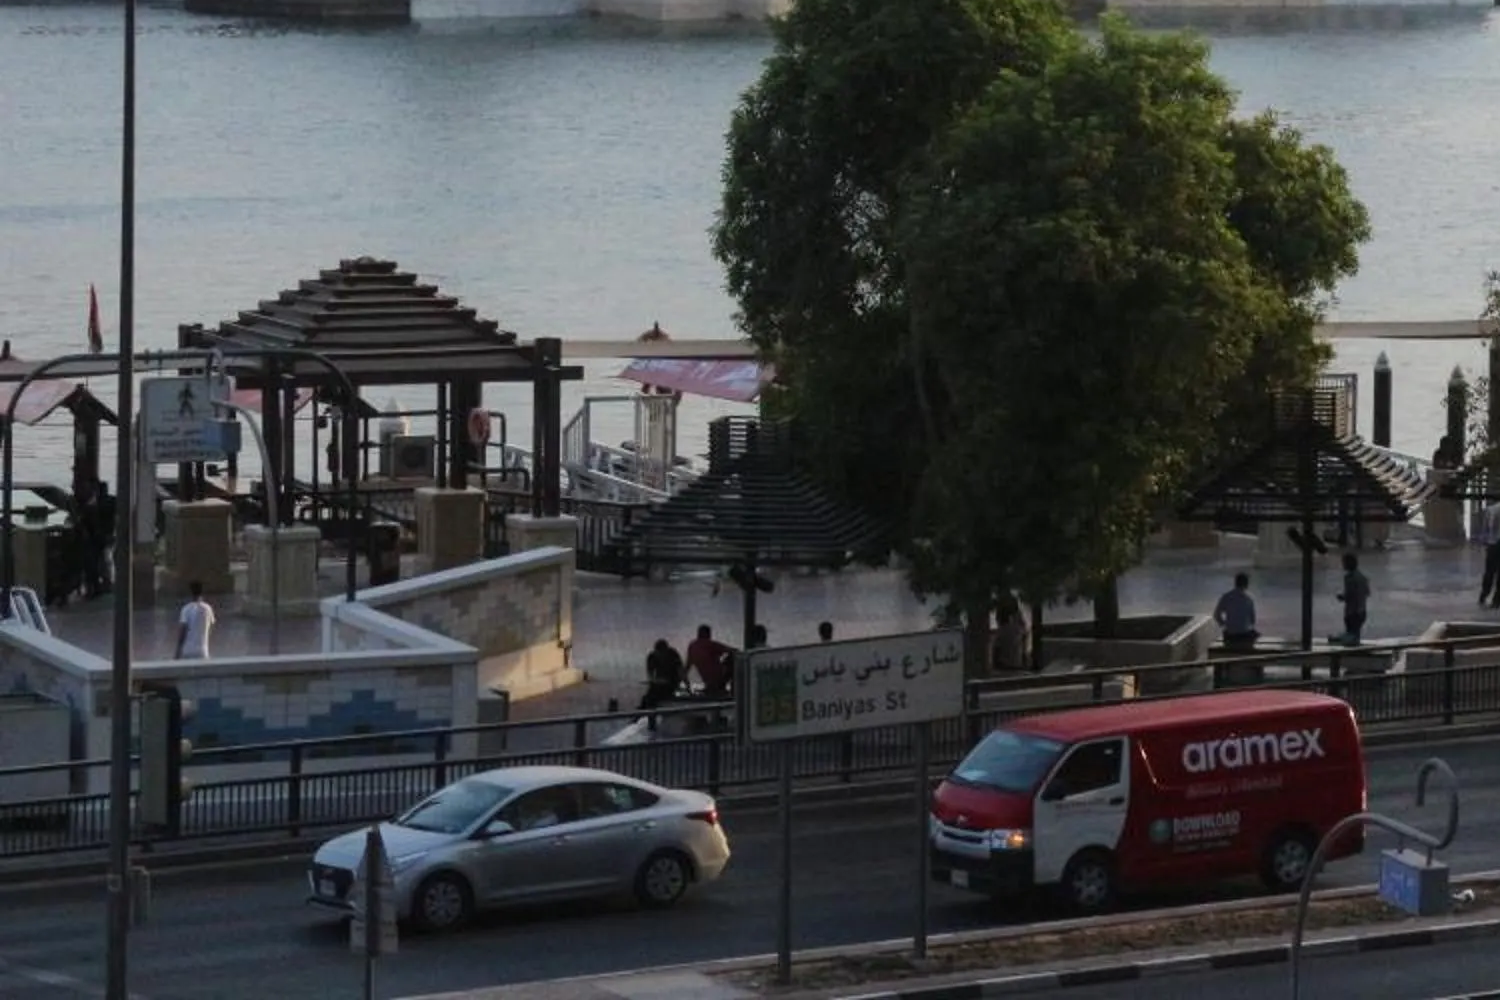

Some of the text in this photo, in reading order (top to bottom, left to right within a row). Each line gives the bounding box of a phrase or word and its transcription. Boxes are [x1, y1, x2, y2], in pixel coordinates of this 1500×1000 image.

[801, 641, 961, 687] شارع بني ياس
[802, 691, 908, 721] Baniyas St
[1182, 727, 1325, 773] aramex
